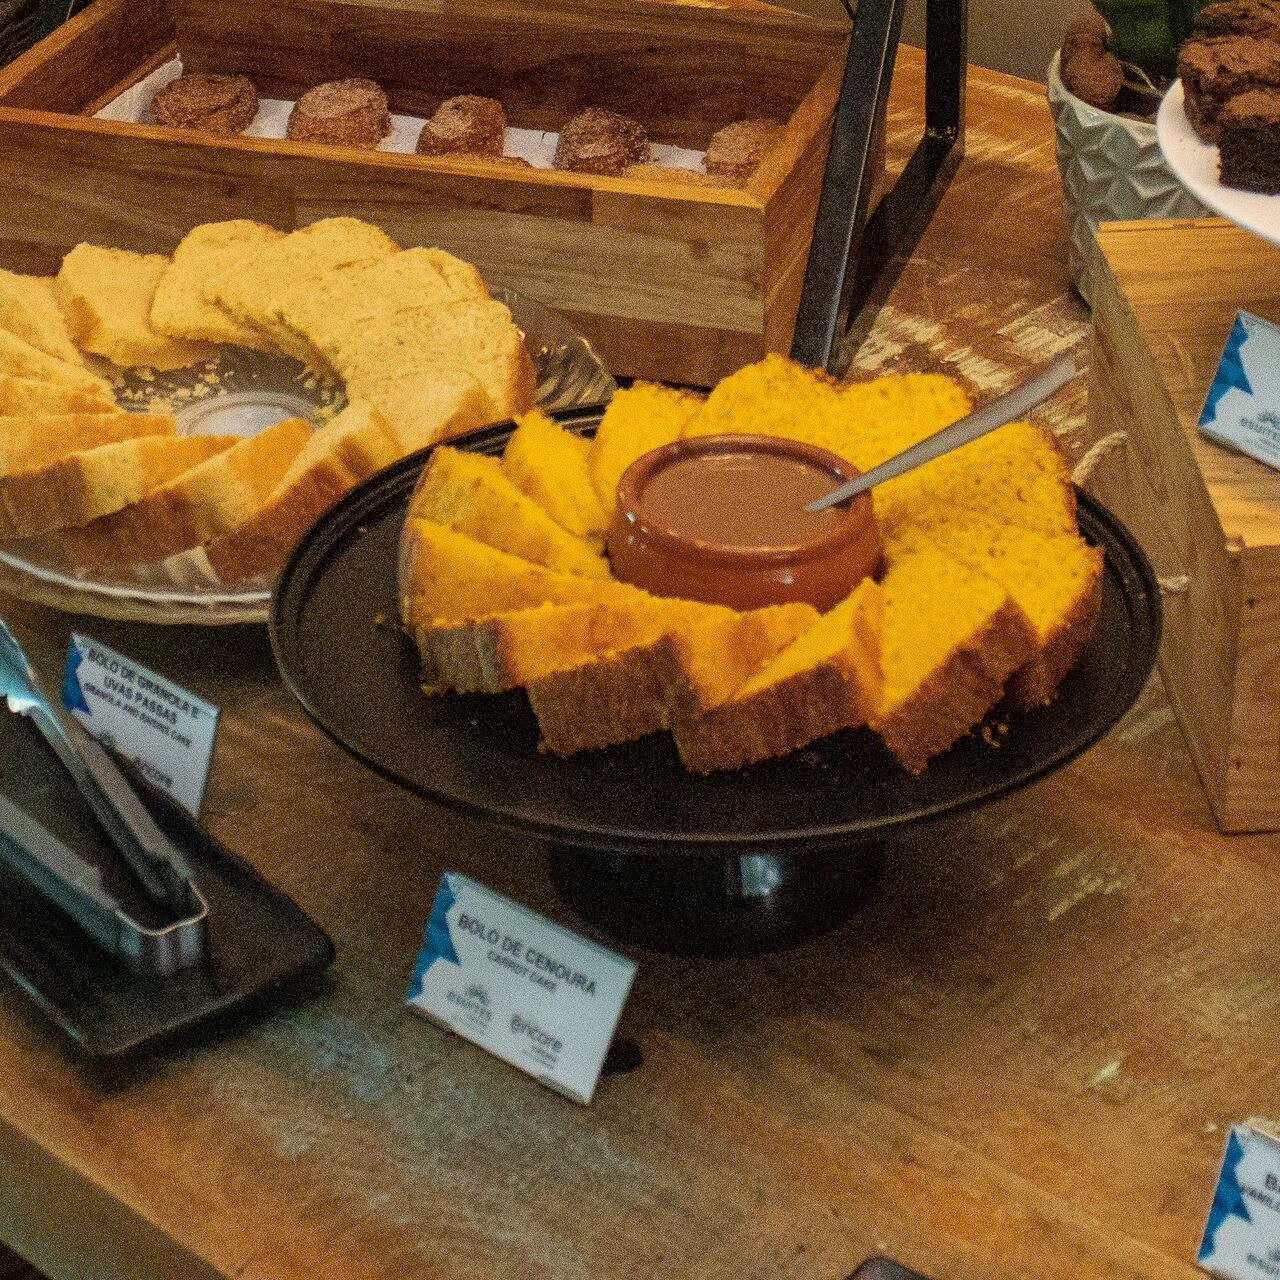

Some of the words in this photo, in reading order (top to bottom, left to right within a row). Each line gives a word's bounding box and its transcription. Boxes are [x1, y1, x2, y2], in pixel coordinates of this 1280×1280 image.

[88, 648, 119, 672] BOLO
[120, 664, 136, 679] DE
[137, 676, 189, 711] GRANOLA
[104, 676, 134, 700] UVAS
[135, 692, 177, 724] PASSAS
[458, 913, 499, 945] BOLO
[502, 937, 522, 957] DE
[525, 949, 597, 997] CENOURA
[487, 950, 528, 977] CARROT
[529, 971, 558, 993] CAKE
